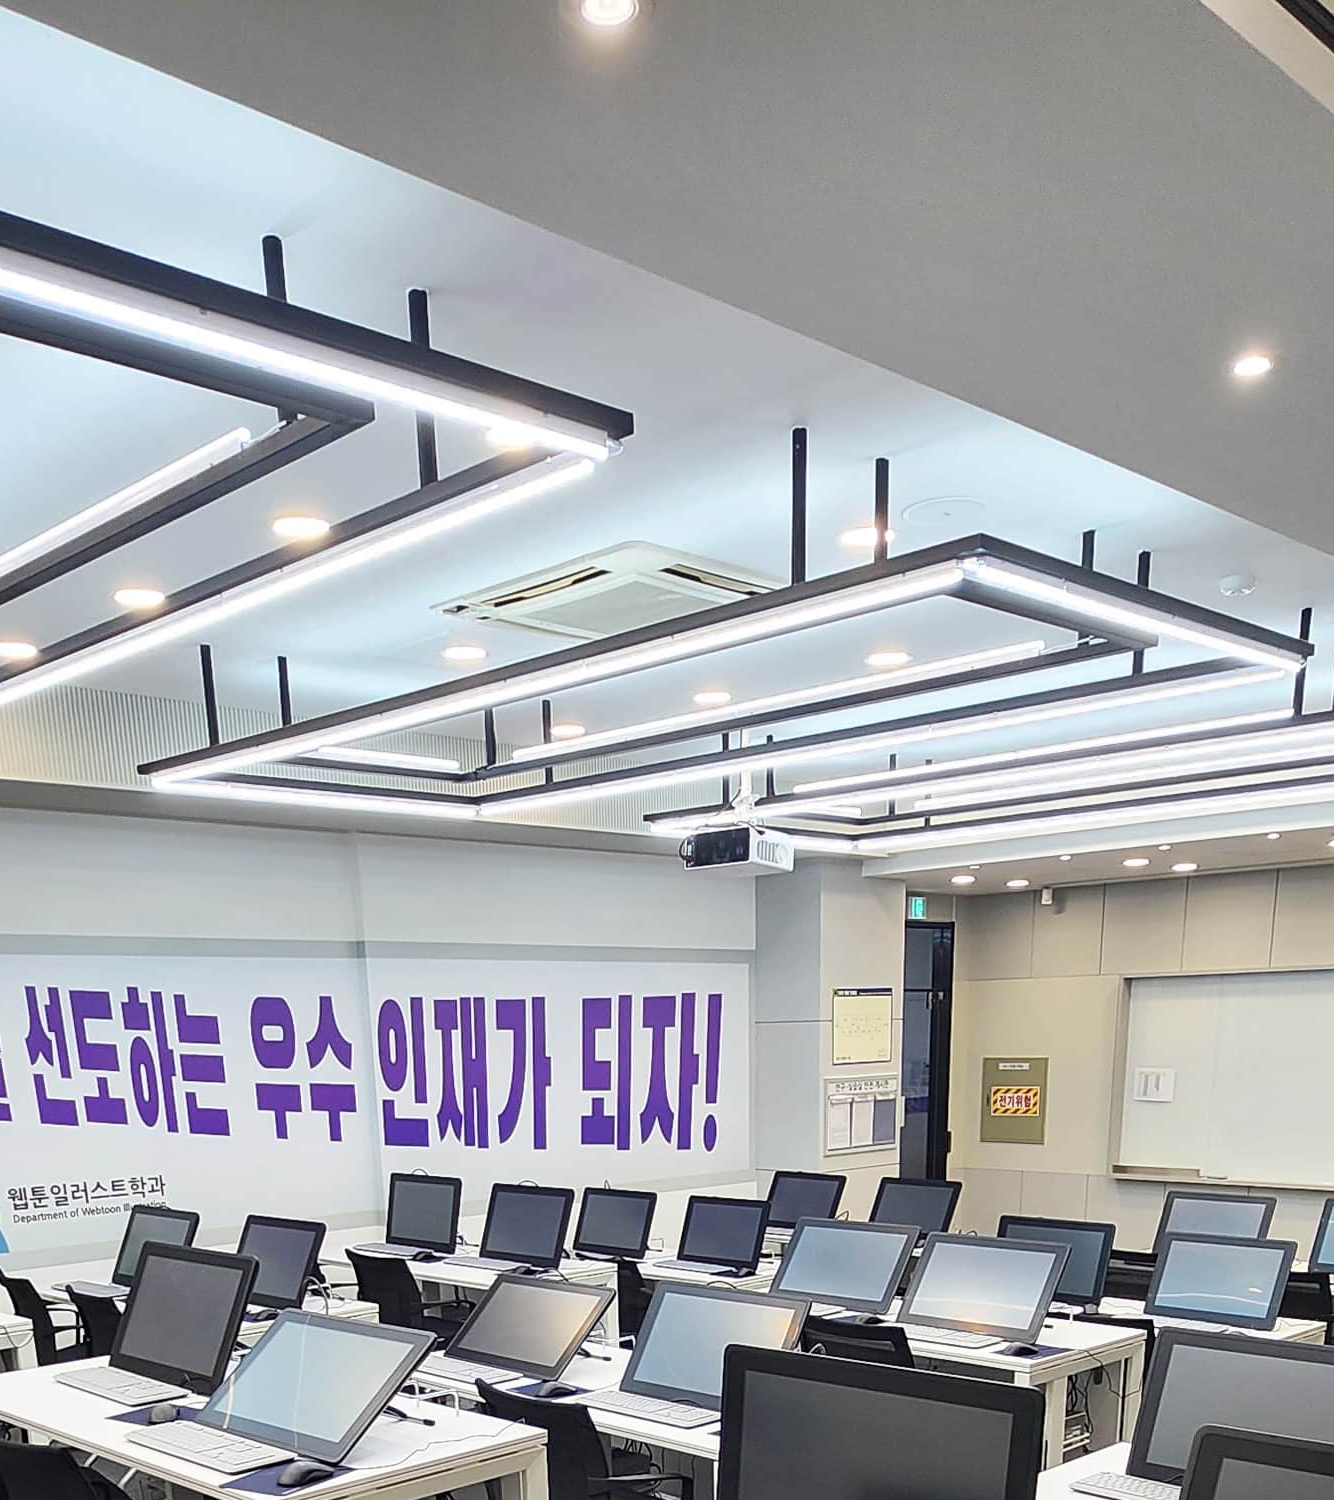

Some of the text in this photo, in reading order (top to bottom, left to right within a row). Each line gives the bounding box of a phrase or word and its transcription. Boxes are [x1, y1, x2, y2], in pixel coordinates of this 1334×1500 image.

[24, 985, 231, 1136] 선도하는
[249, 995, 358, 1143] 우수
[376, 995, 552, 1150] 인재가
[580, 992, 723, 1152] 되자!
[998, 1095, 1032, 1108] 전기위험
[7, 1175, 167, 1212] 웹툰일러스트학과
[12, 1210, 68, 1224] Department
[70, 1208, 79, 1218] of
[81, 1204, 122, 1217] Webtoon
